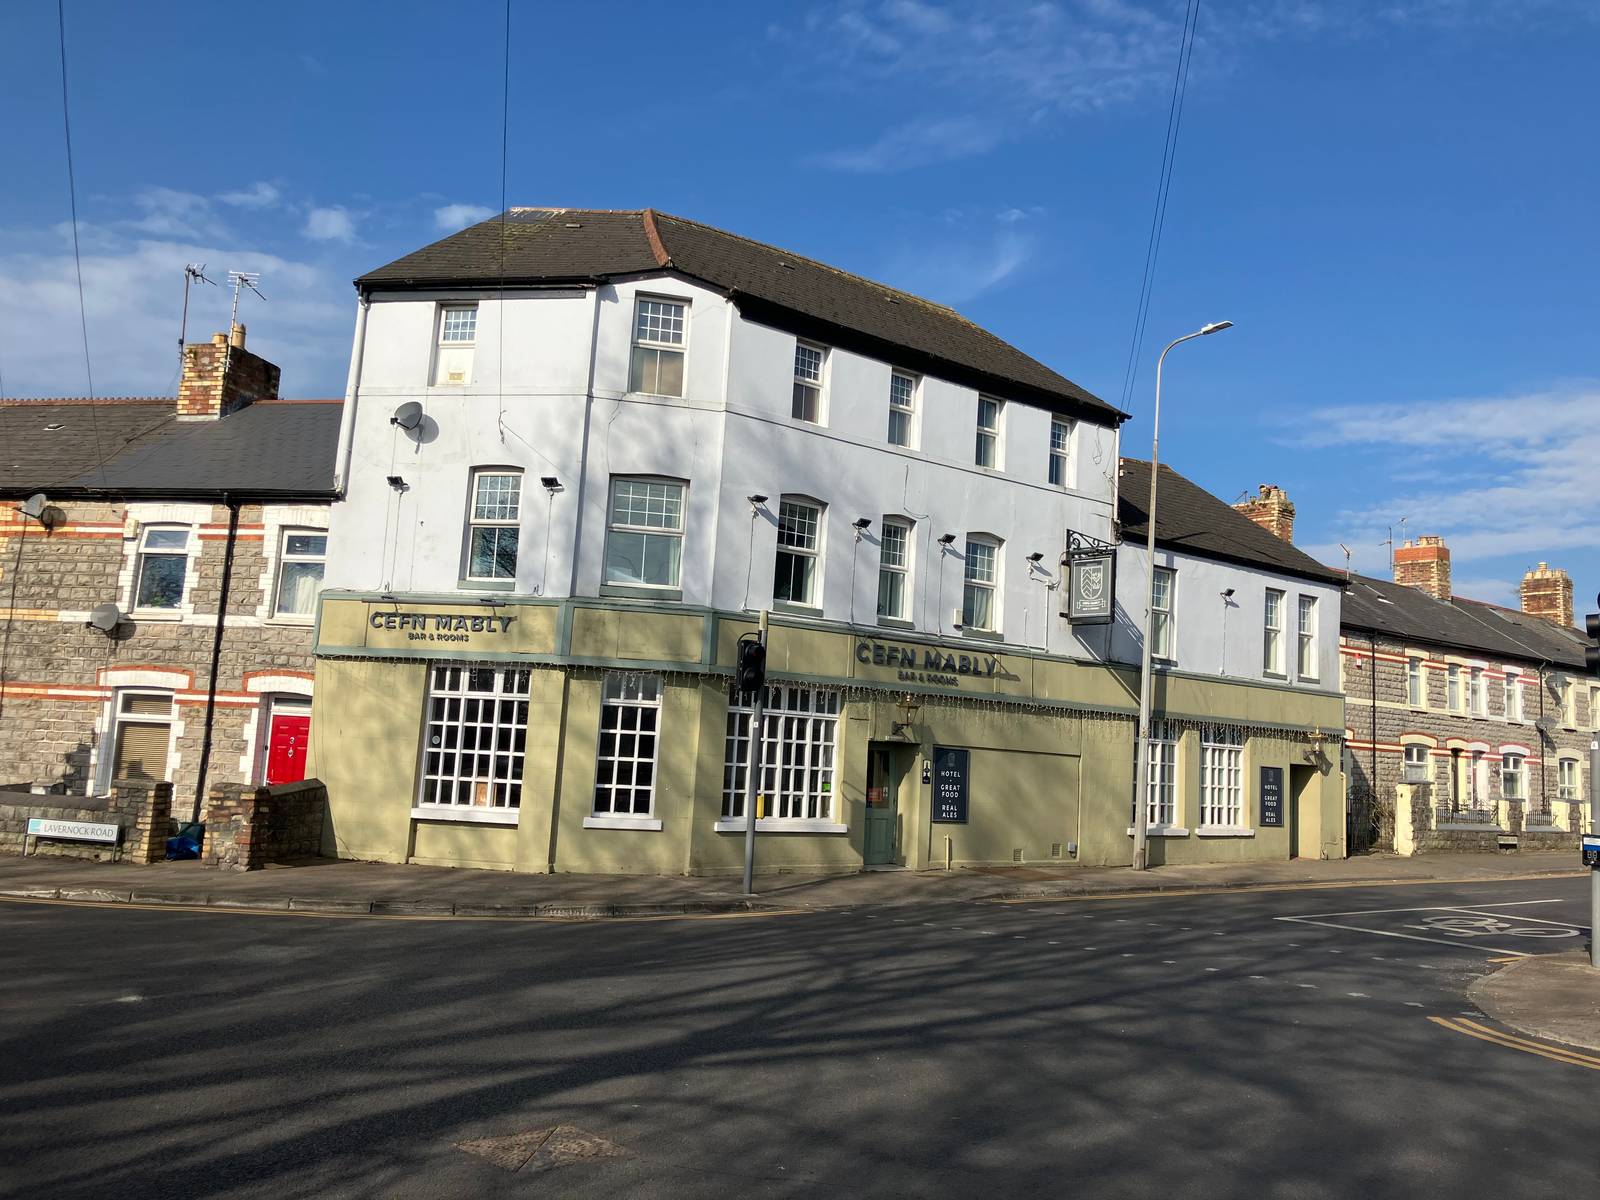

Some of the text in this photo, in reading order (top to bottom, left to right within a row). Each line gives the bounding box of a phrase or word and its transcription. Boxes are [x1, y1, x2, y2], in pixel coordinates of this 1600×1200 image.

[370, 611, 511, 633] CEFN MABLY
[408, 632, 470, 642] BAR & ROOMS
[856, 643, 997, 677] CEFN MABLY
[898, 671, 916, 682] BAR
[926, 673, 959, 687] ROOMS
[940, 770, 961, 778] HOTEL
[43, 823, 114, 838] LAVERNOCK ROAD
